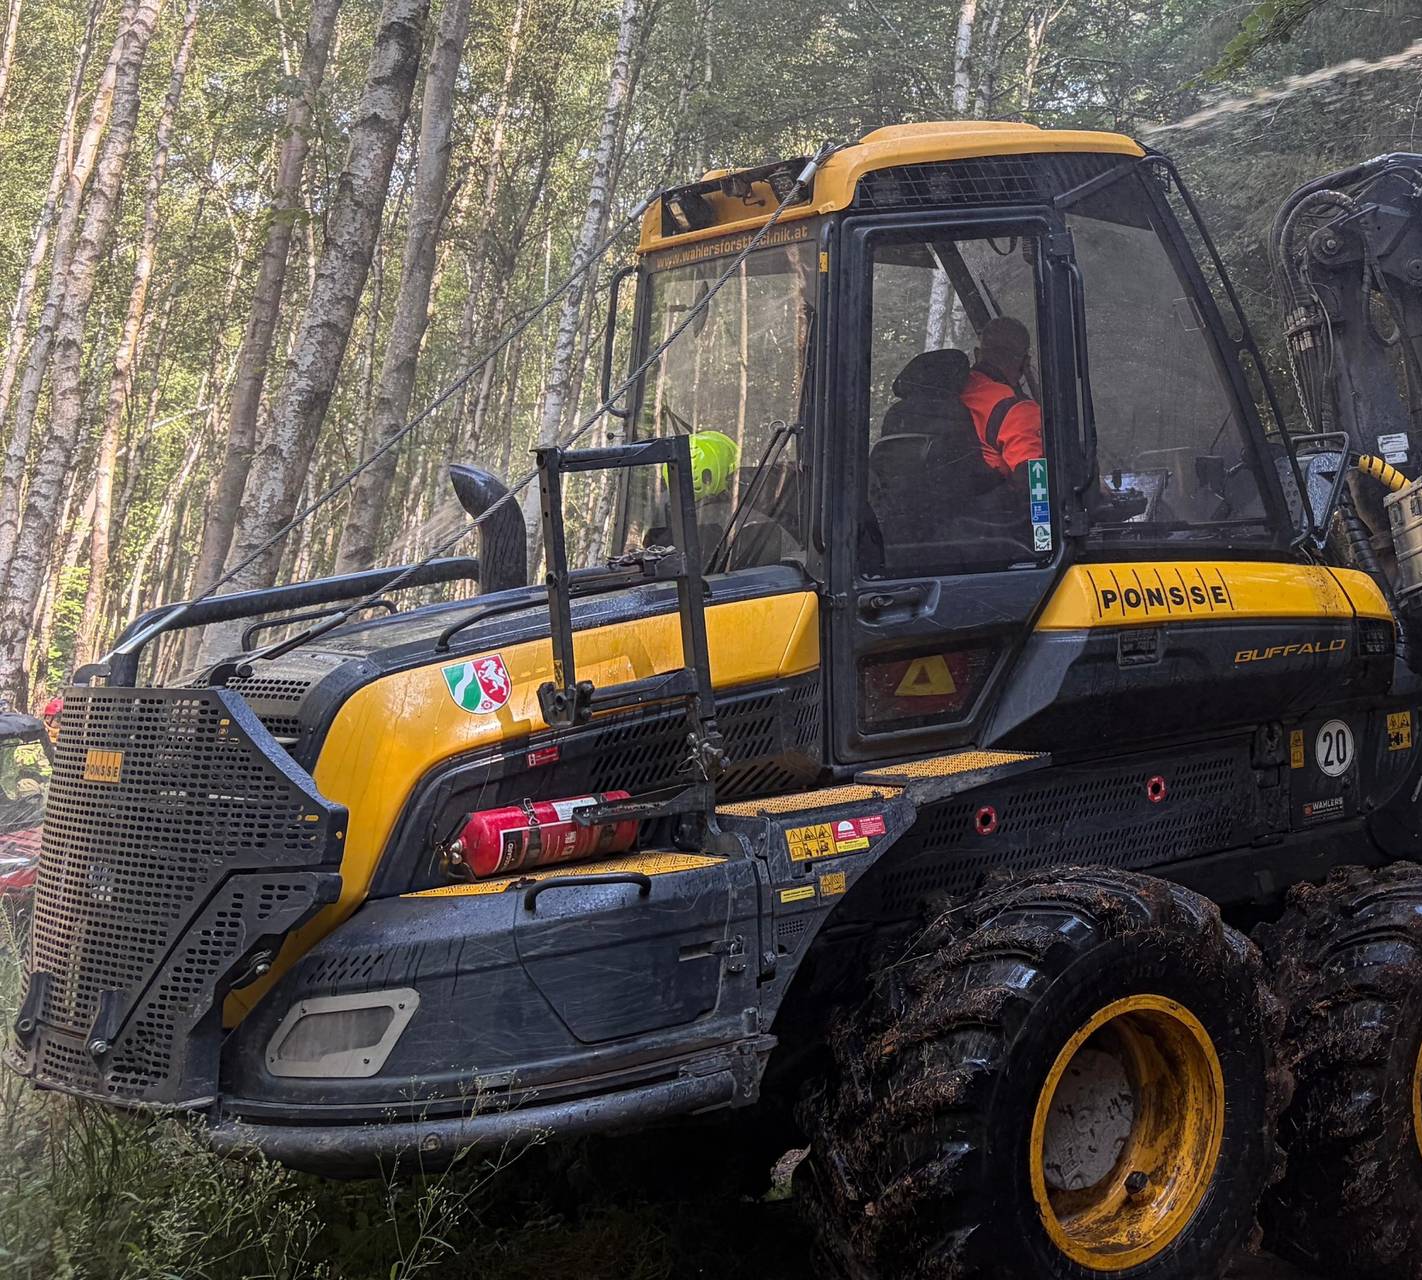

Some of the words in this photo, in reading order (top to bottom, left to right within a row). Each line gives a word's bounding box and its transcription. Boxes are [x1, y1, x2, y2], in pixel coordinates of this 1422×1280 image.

[656, 224, 808, 269] www.wahlersforsttchnik.at
[1101, 585, 1227, 609] PONSSE
[1234, 638, 1346, 664] BUFFALO
[1322, 728, 1347, 767] 20
[85, 763, 119, 778] PONSSE
